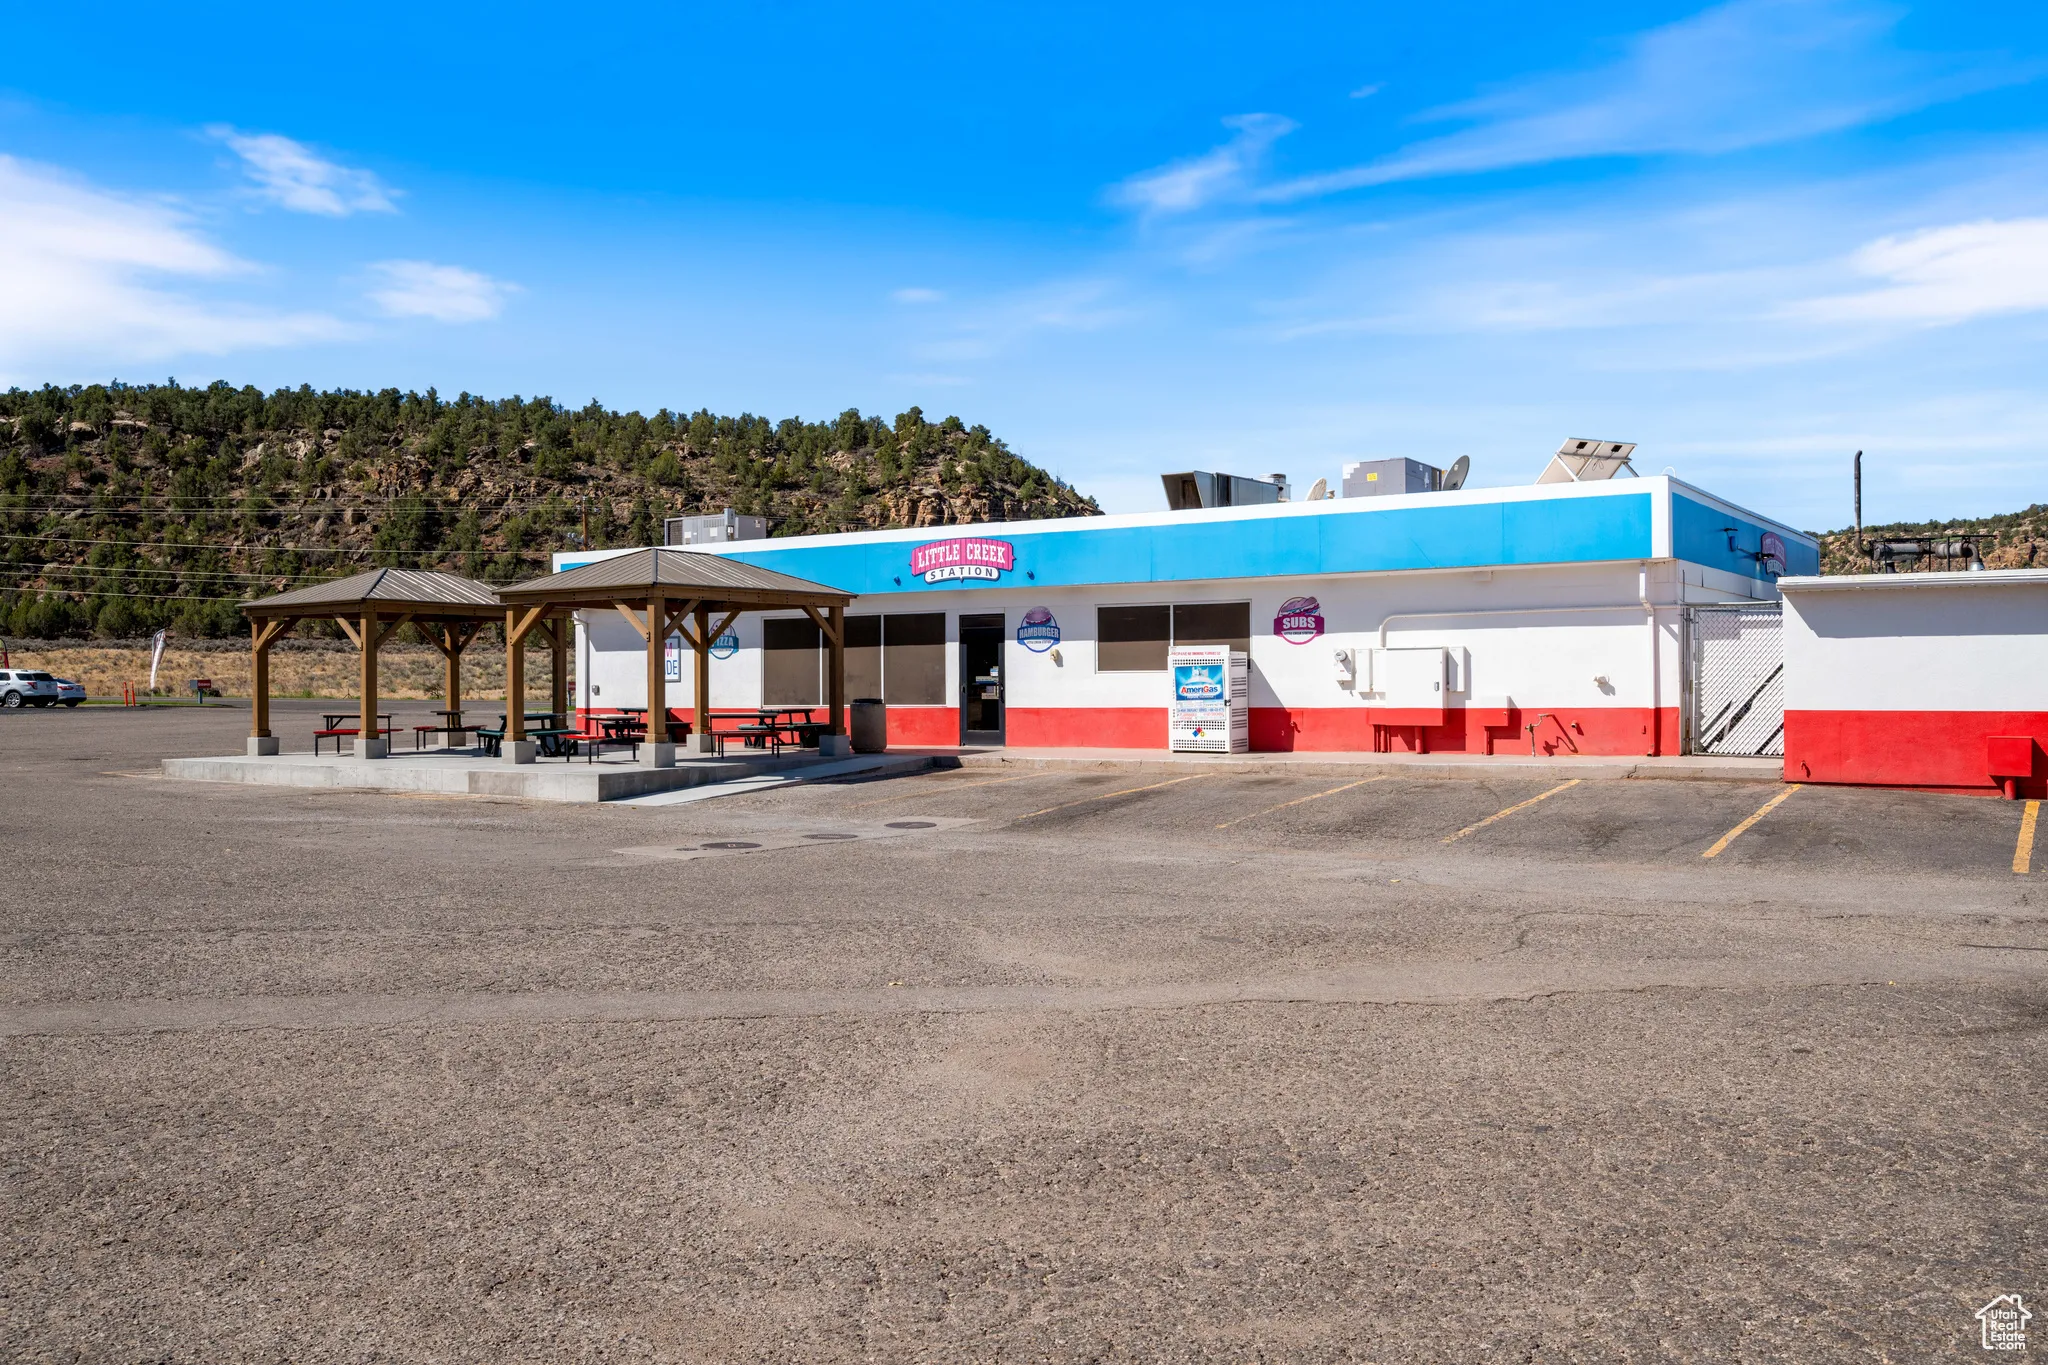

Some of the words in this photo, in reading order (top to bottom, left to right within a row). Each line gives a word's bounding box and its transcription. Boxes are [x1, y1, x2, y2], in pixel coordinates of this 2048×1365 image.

[918, 544, 960, 568] LITTLE
[966, 543, 1006, 564] CREEK
[930, 566, 993, 580] STATION
[1282, 616, 1316, 629] SUBS
[1019, 626, 1059, 639] HAMBURGER
[1181, 685, 1219, 694] AmeriGas
